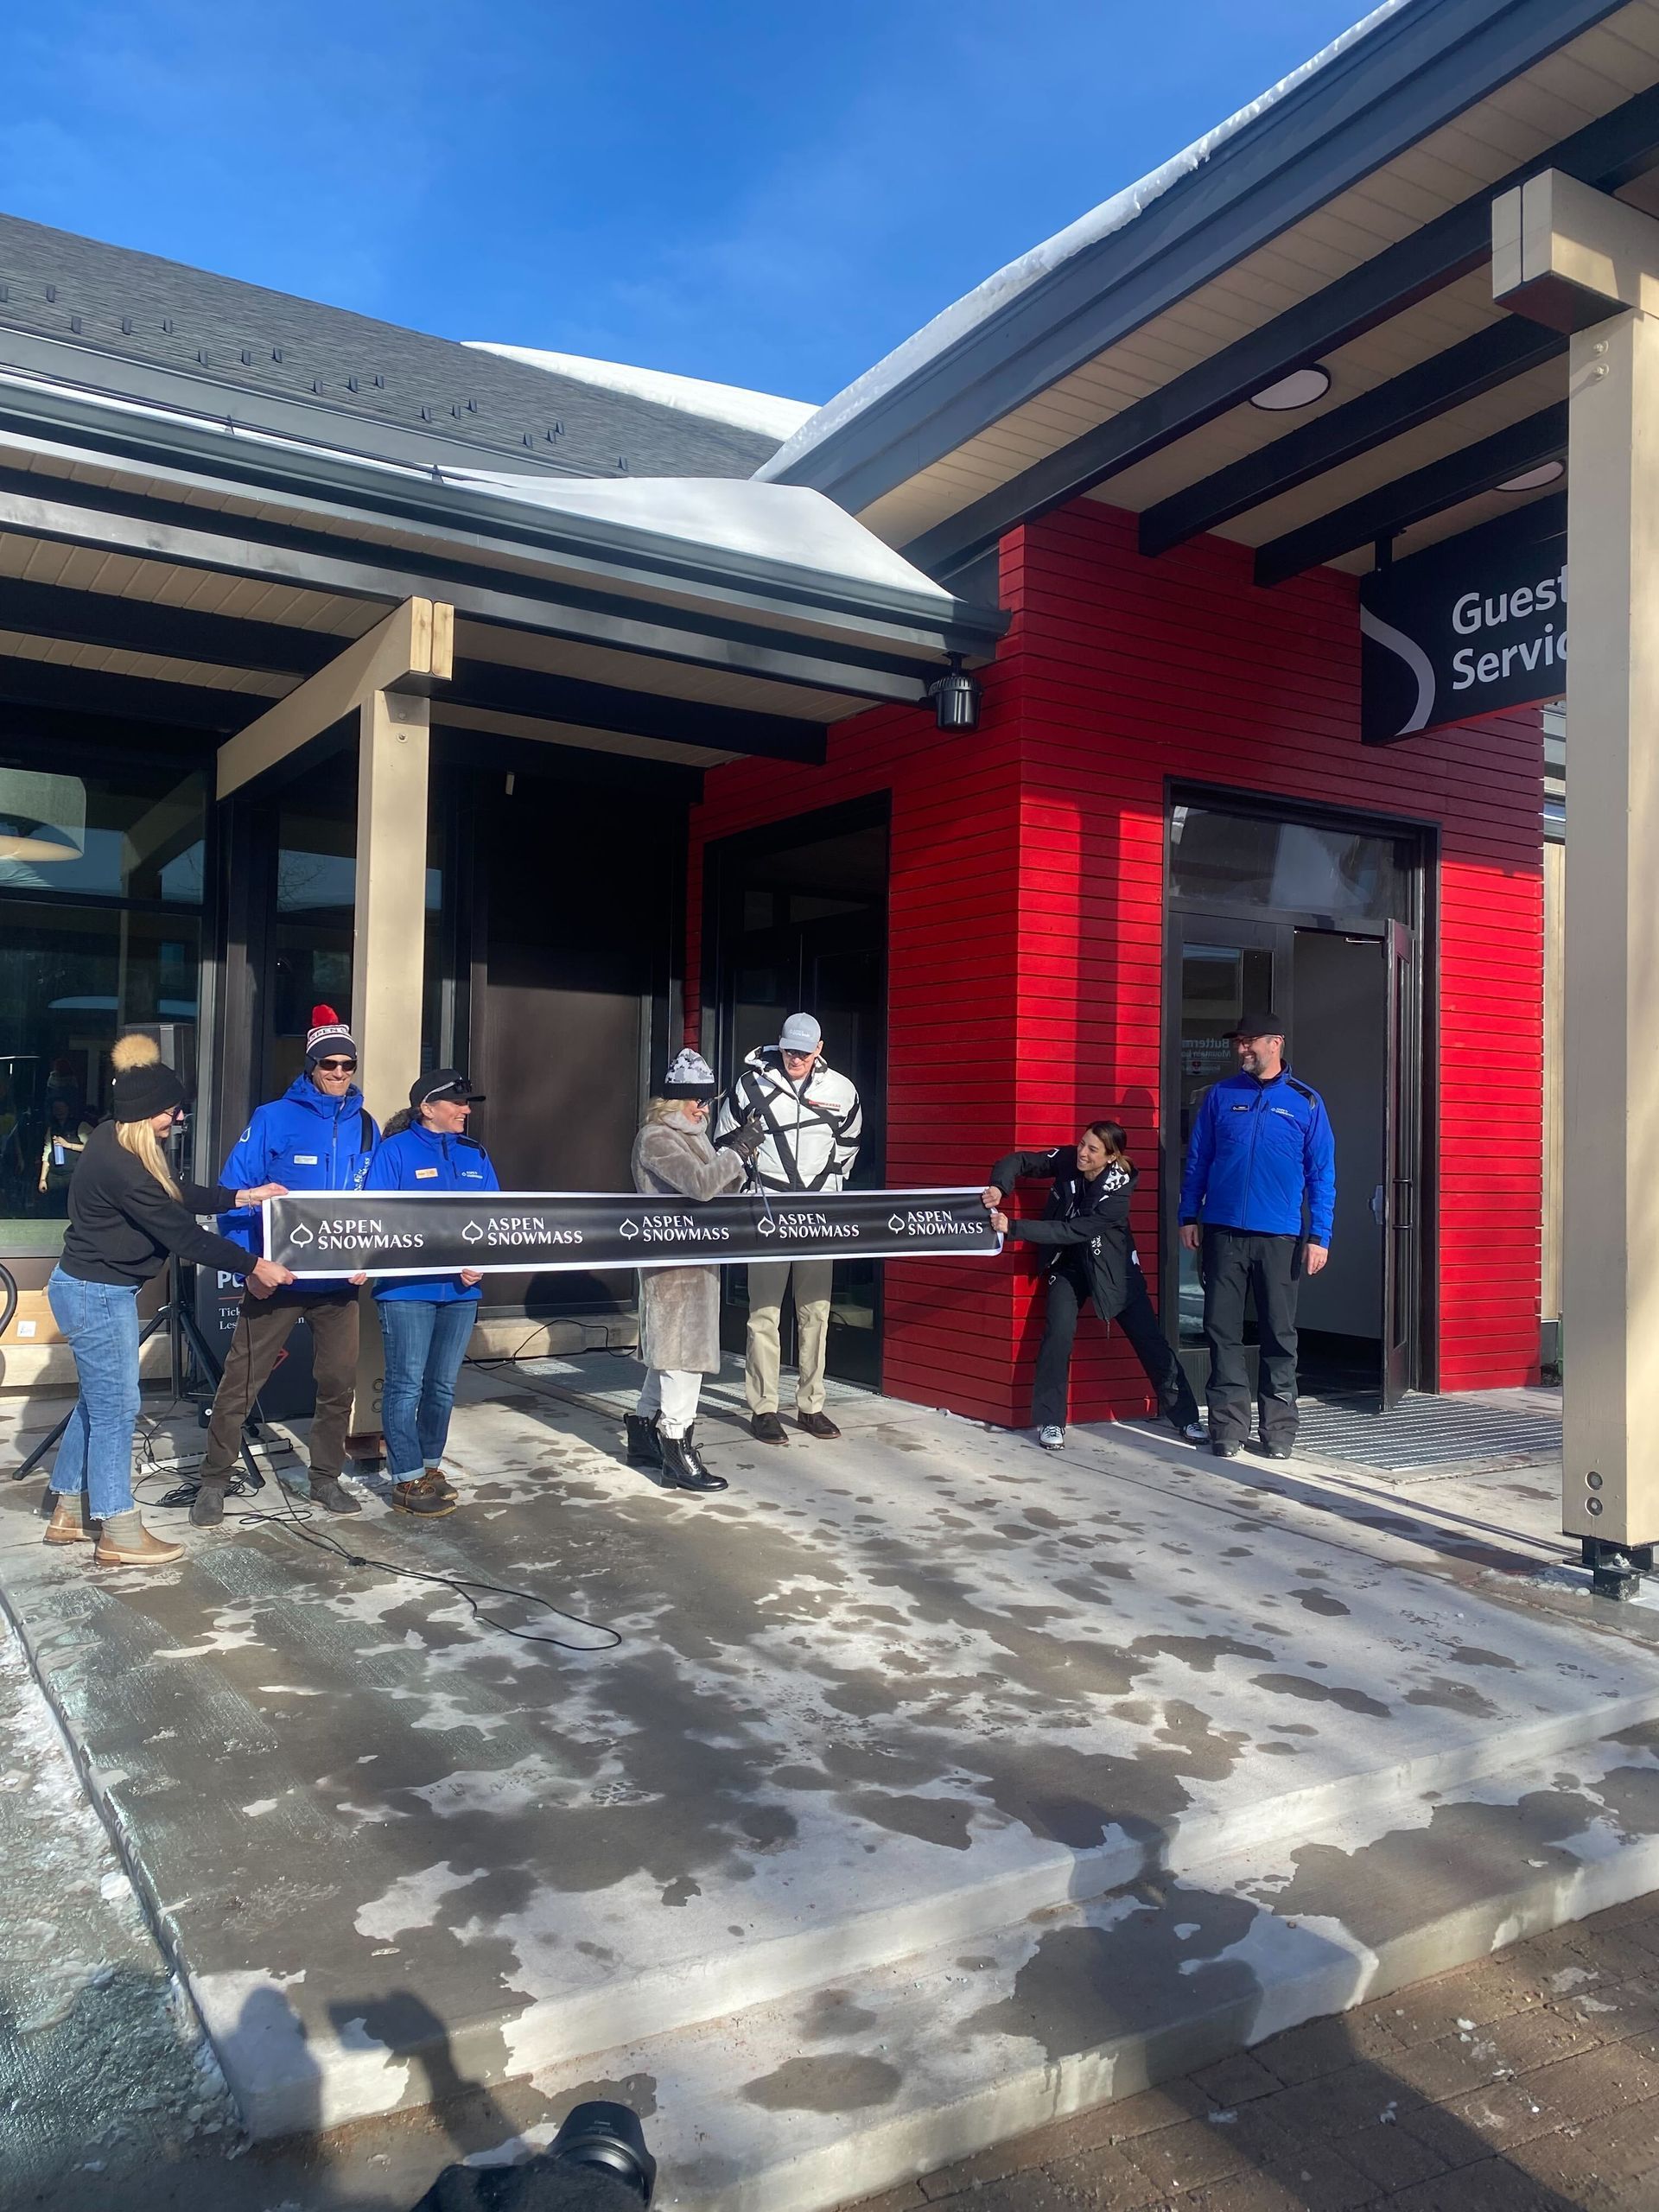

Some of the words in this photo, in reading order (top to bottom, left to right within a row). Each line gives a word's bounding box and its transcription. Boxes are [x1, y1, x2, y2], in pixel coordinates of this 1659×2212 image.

[1452, 564, 1568, 635] Guest
[487, 1217, 545, 1231] ASPEN
[642, 1215, 694, 1228] ASPEN
[779, 1213, 827, 1225] ASPEN
[907, 1211, 952, 1223] ASPEN
[318, 1219, 385, 1235] ASPEN
[642, 1227, 730, 1242] SNOWMASS
[779, 1224, 860, 1239] SNOWMASS
[907, 1223, 983, 1236] SNOWMASS
[317, 1233, 424, 1250] SNOWMASS
[487, 1230, 583, 1246] SNOWMASS
